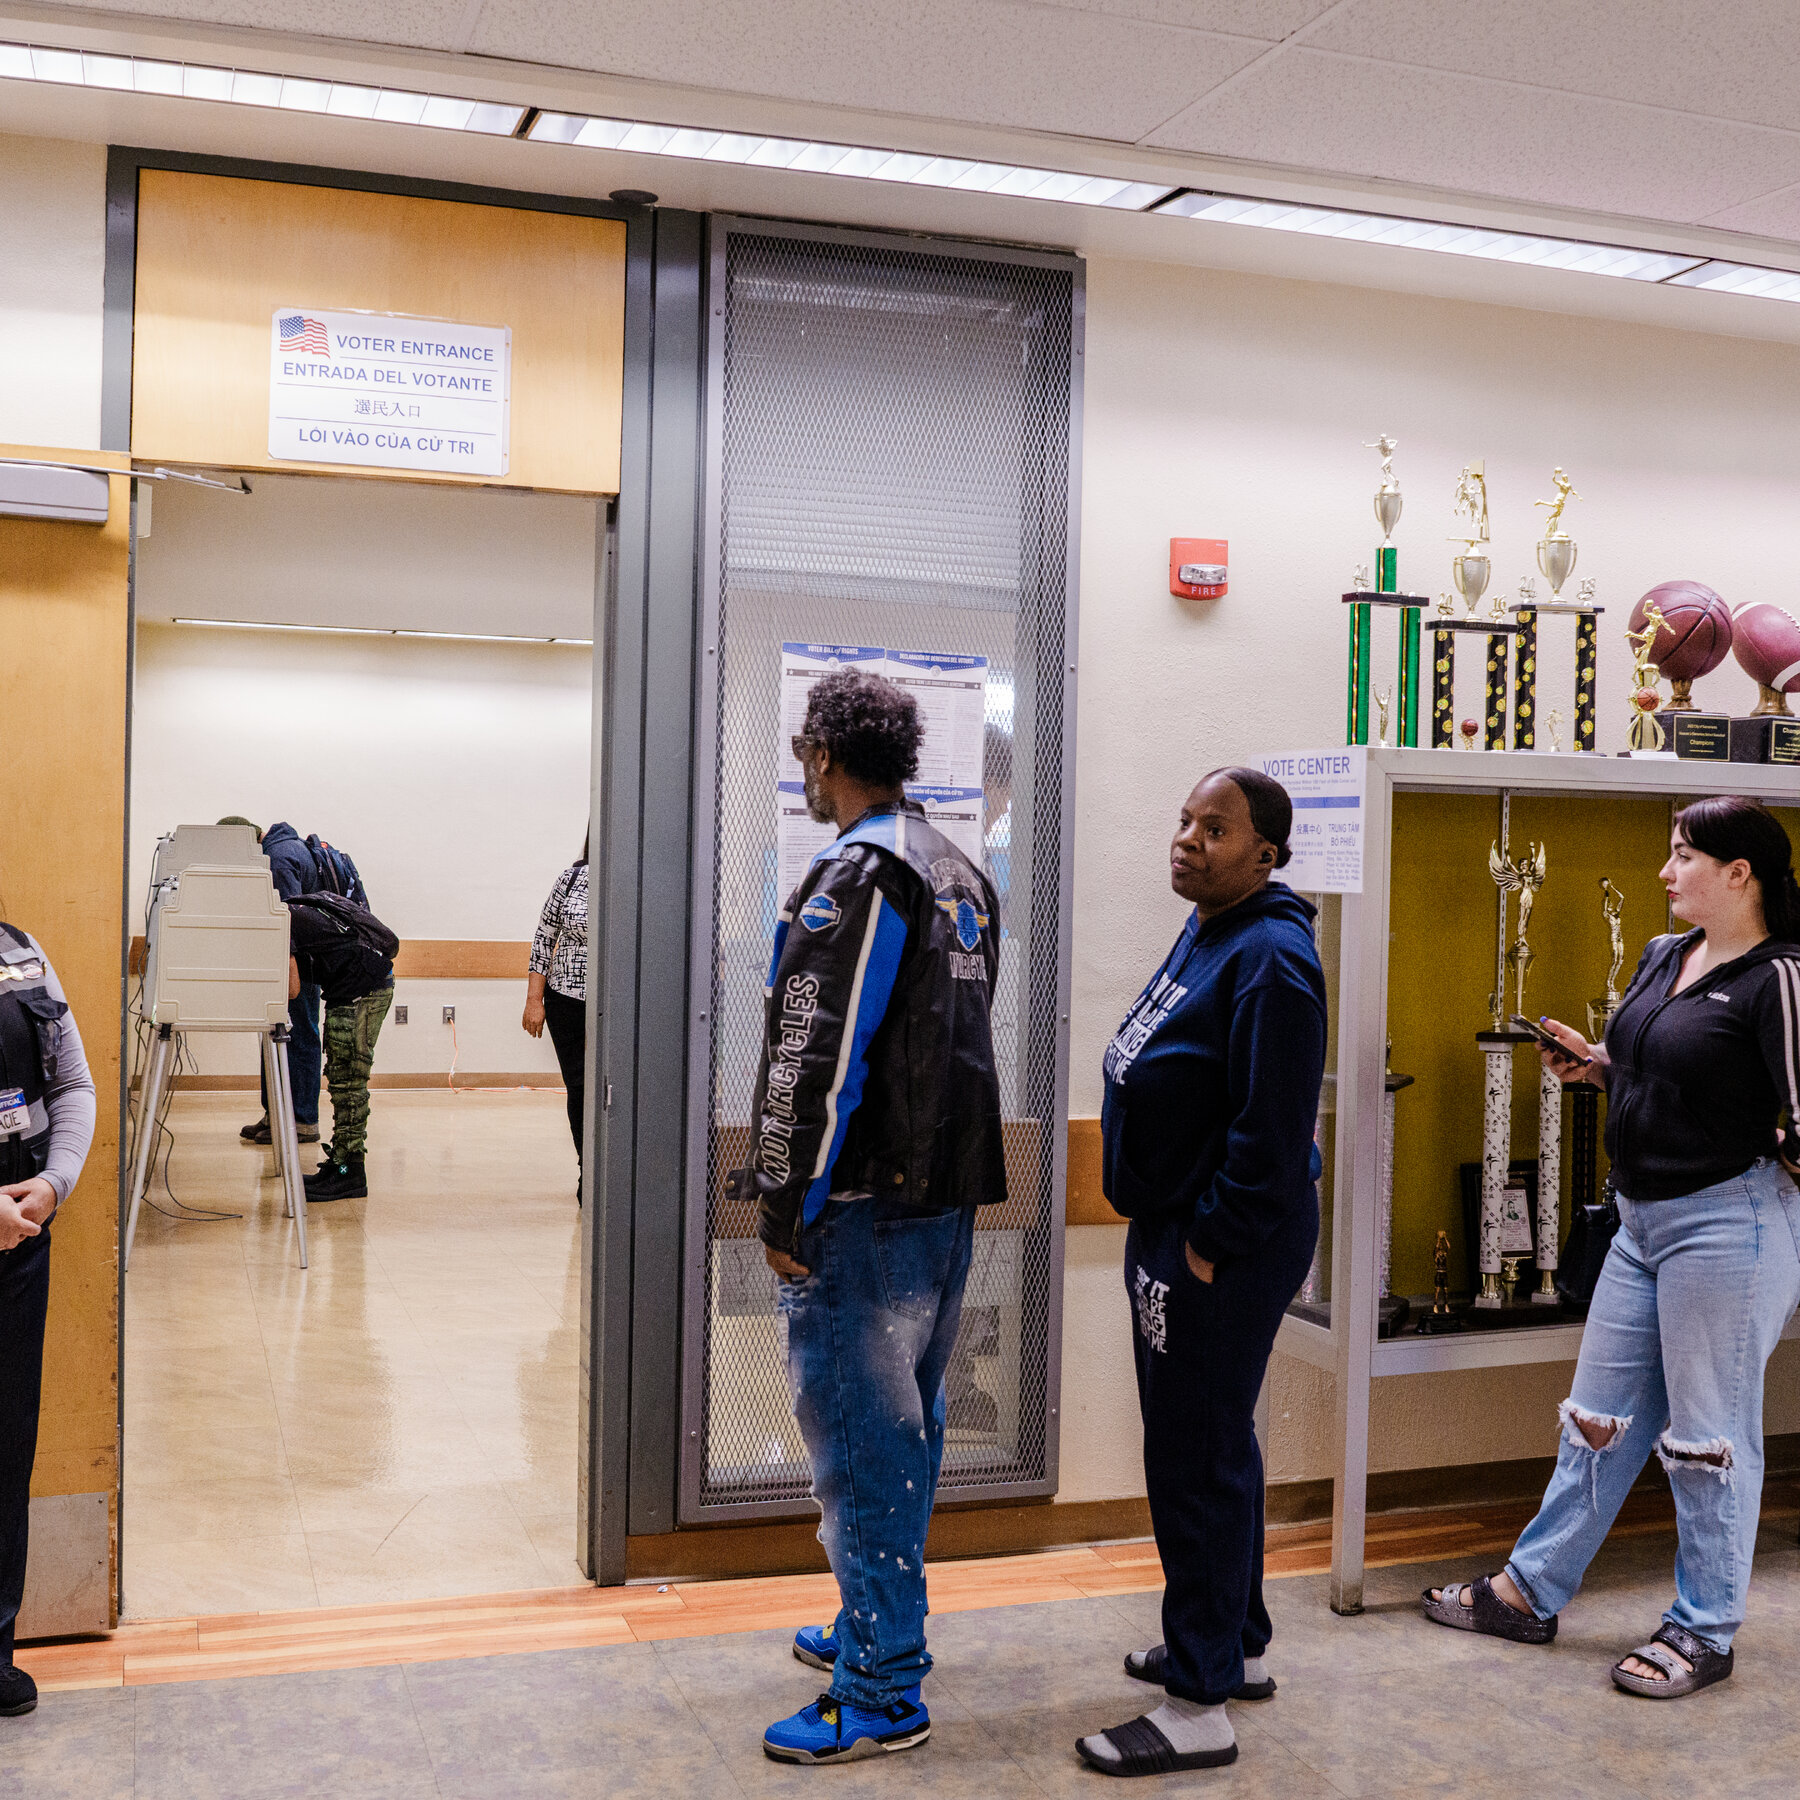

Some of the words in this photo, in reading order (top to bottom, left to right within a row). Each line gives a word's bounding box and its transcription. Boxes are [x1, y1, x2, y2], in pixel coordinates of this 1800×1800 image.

[336, 335, 395, 352] VOTER
[401, 340, 494, 361] ENTRANCE
[283, 362, 368, 381] ENTRADA
[373, 369, 407, 385] DEL
[412, 373, 493, 392] VOTANTE
[354, 399, 421, 418] 選民入口
[332, 429, 369, 446] VÀO
[375, 432, 412, 449] CỦA
[417, 435, 444, 452] CỬ
[448, 440, 475, 455] TRI
[1191, 586, 1217, 596] FIRE
[1263, 759, 1295, 776] VOTE
[1298, 756, 1350, 776] CENTER
[1328, 823, 1347, 833] TRUNG
[763, 975, 820, 1185] MOTORCYCLES
